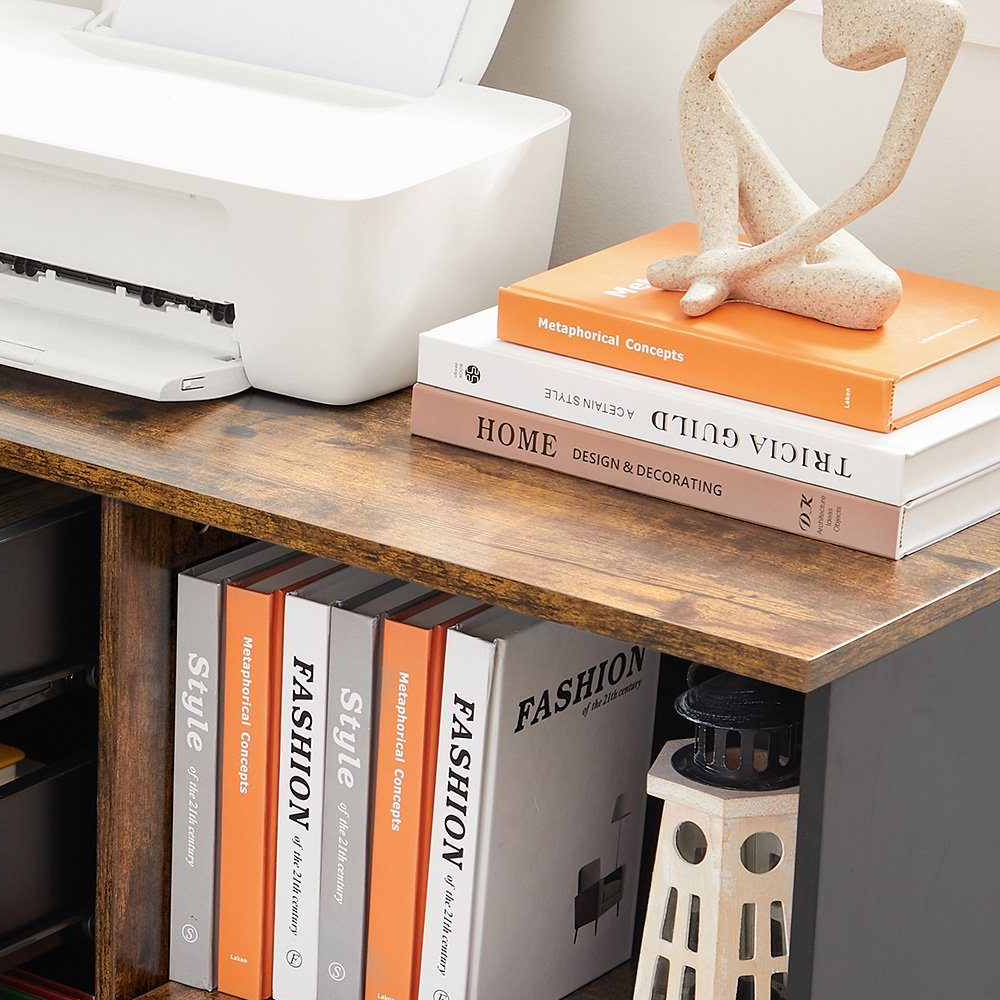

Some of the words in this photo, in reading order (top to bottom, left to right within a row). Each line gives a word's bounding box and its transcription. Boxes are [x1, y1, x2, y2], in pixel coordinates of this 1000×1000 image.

[538, 317, 620, 346] Metaphorical
[625, 338, 684, 362] Concepts
[544, 388, 580, 406] STYLE
[583, 399, 625, 418] CETAIN
[627, 409, 635, 419] A
[651, 410, 739, 449] GUILD
[477, 416, 557, 458] HOME
[572, 447, 620, 471] DESIGN
[623, 461, 634, 473] &
[637, 464, 723, 496] DECORATING
[750, 434, 852, 478] TRICIA
[817, 495, 826, 535] Architecture
[834, 506, 842, 533] Objects
[240, 636, 253, 727] Metaphorical
[513, 645, 646, 733] FASHION
[581, 702, 591, 717] of
[591, 697, 601, 711] the
[602, 689, 618, 706] 21th
[618, 680, 643, 697] century
[182, 653, 210, 752] Style
[394, 671, 409, 763] Metaphorical
[288, 656, 314, 831] FASHION
[332, 687, 363, 788] Style
[187, 766, 198, 781] of
[238, 731, 251, 795] Concepts
[442, 693, 475, 871] FASHION
[190, 784, 200, 800] the
[337, 802, 349, 819] of
[390, 768, 405, 832] Concepts
[188, 800, 198, 825] 21th
[339, 819, 349, 834] the
[185, 826, 196, 867] century
[291, 835, 303, 851] of
[293, 850, 303, 869] the
[338, 834, 349, 863] 21th
[292, 869, 302, 895] 21th
[333, 864, 344, 904] century
[444, 874, 456, 890] of
[444, 890, 455, 908] the
[288, 895, 299, 936] century
[442, 908, 454, 934] 21th
[230, 953, 248, 964] Lakon
[437, 934, 449, 976] century
